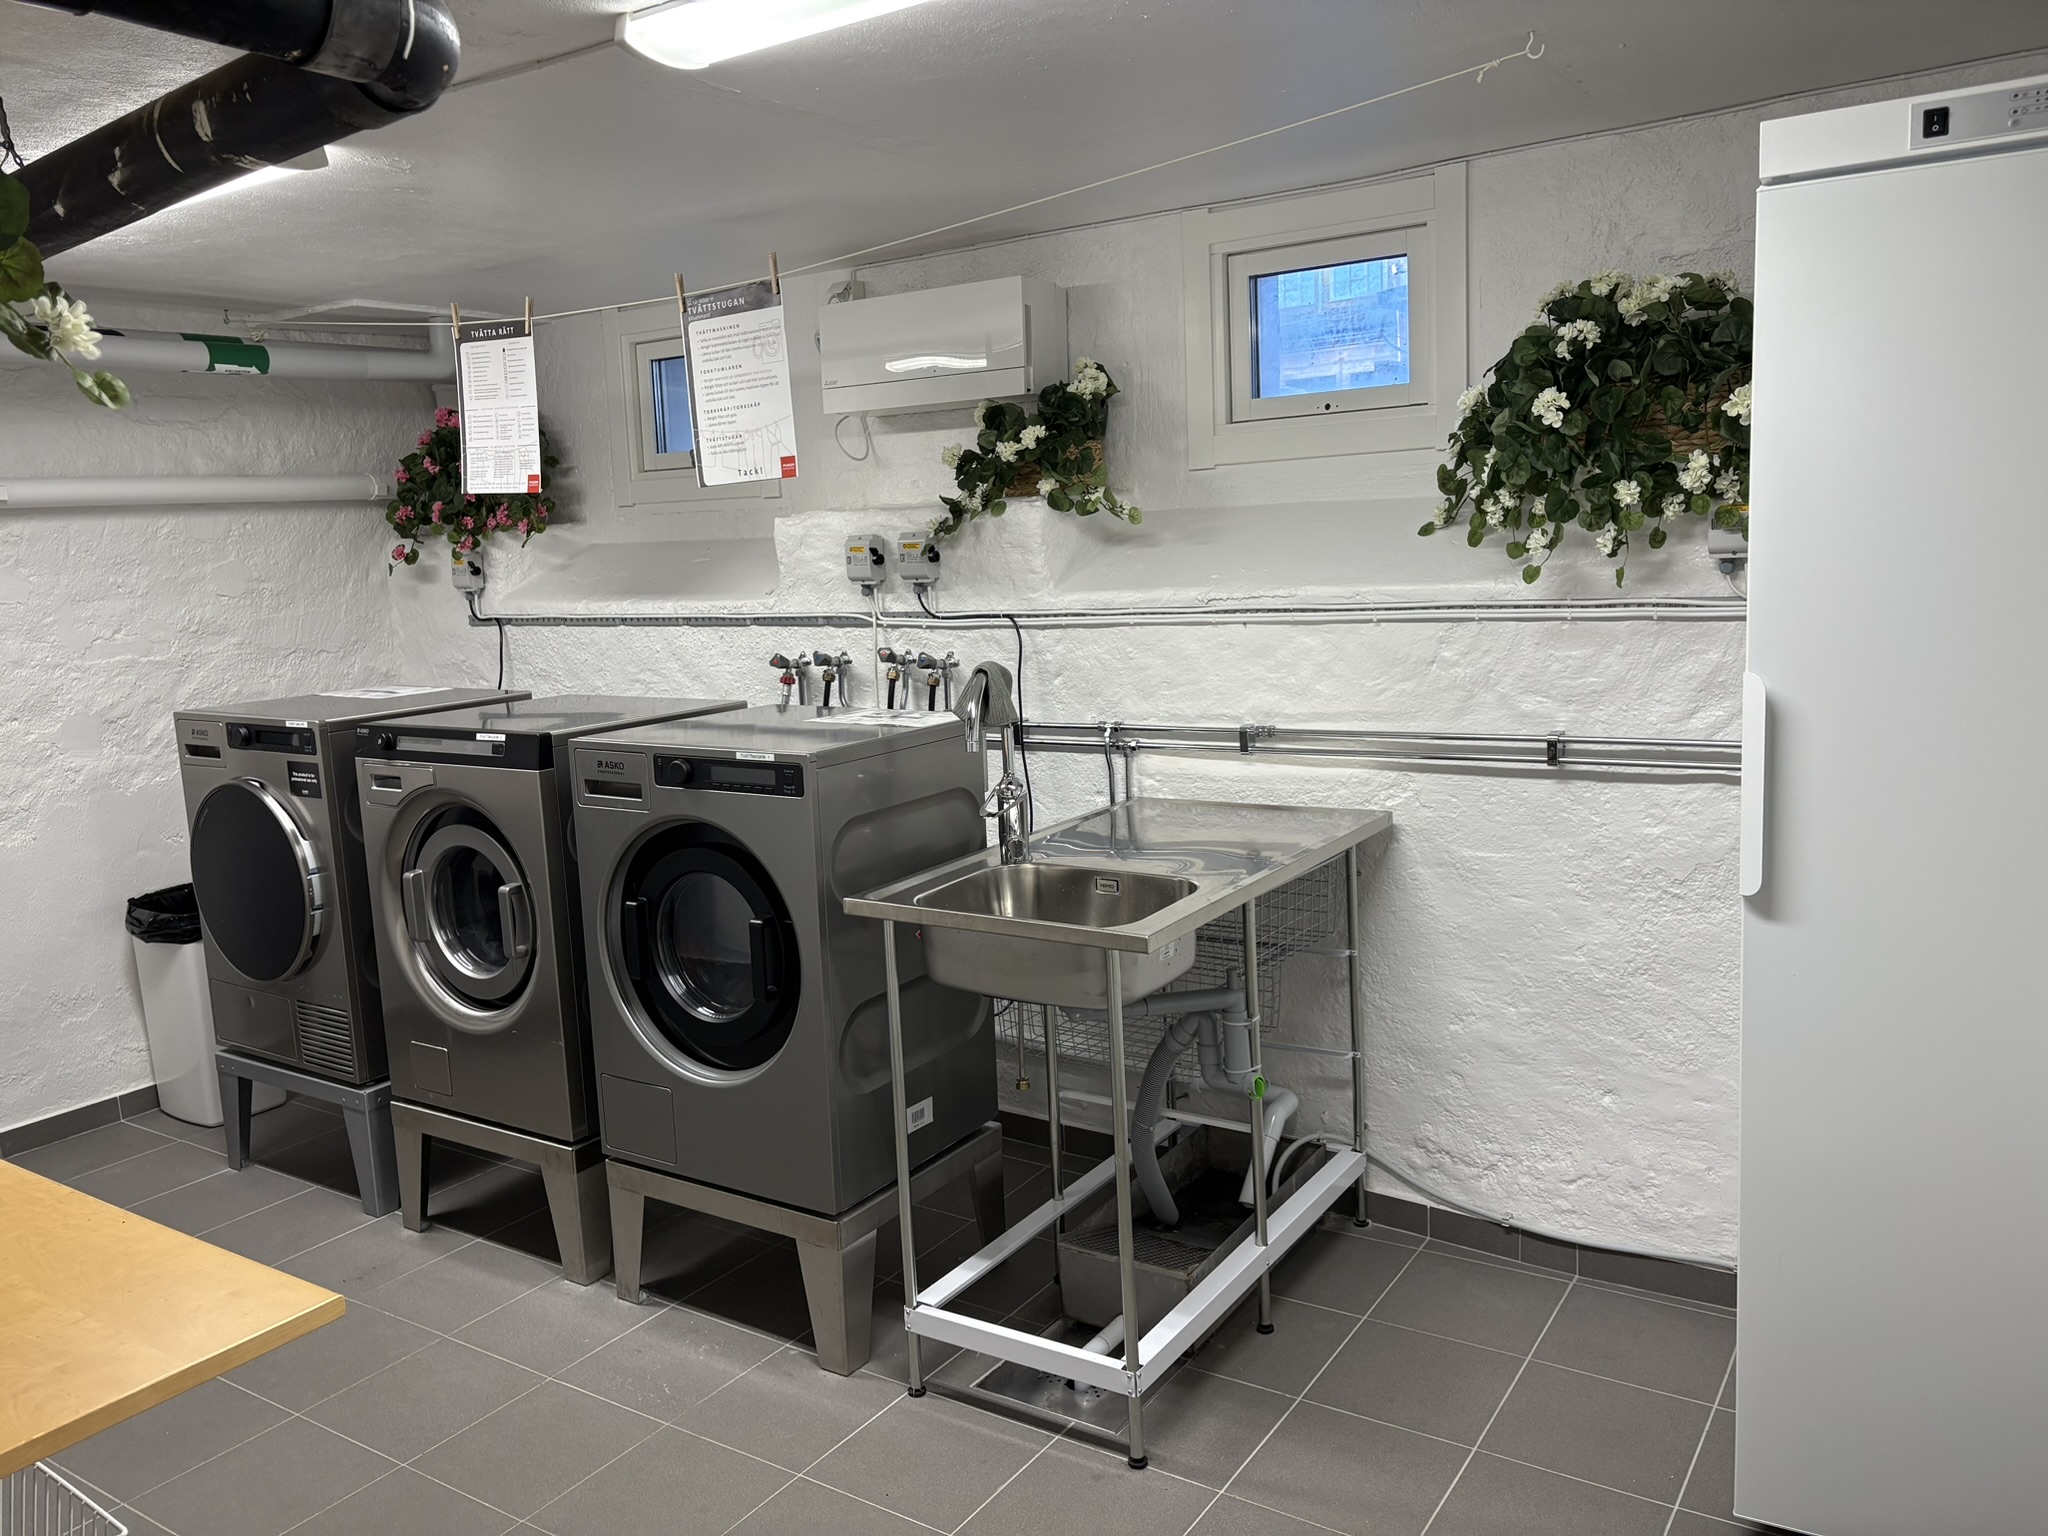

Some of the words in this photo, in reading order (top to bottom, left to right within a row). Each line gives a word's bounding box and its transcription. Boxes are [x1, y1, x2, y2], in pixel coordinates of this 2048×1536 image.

[687, 296, 745, 315] TVÄTTSTUGAN
[471, 328, 497, 338] TVÄTTA
[499, 326, 514, 335] RÄTT
[738, 466, 763, 477] Tack!
[605, 761, 625, 771] ASKO
